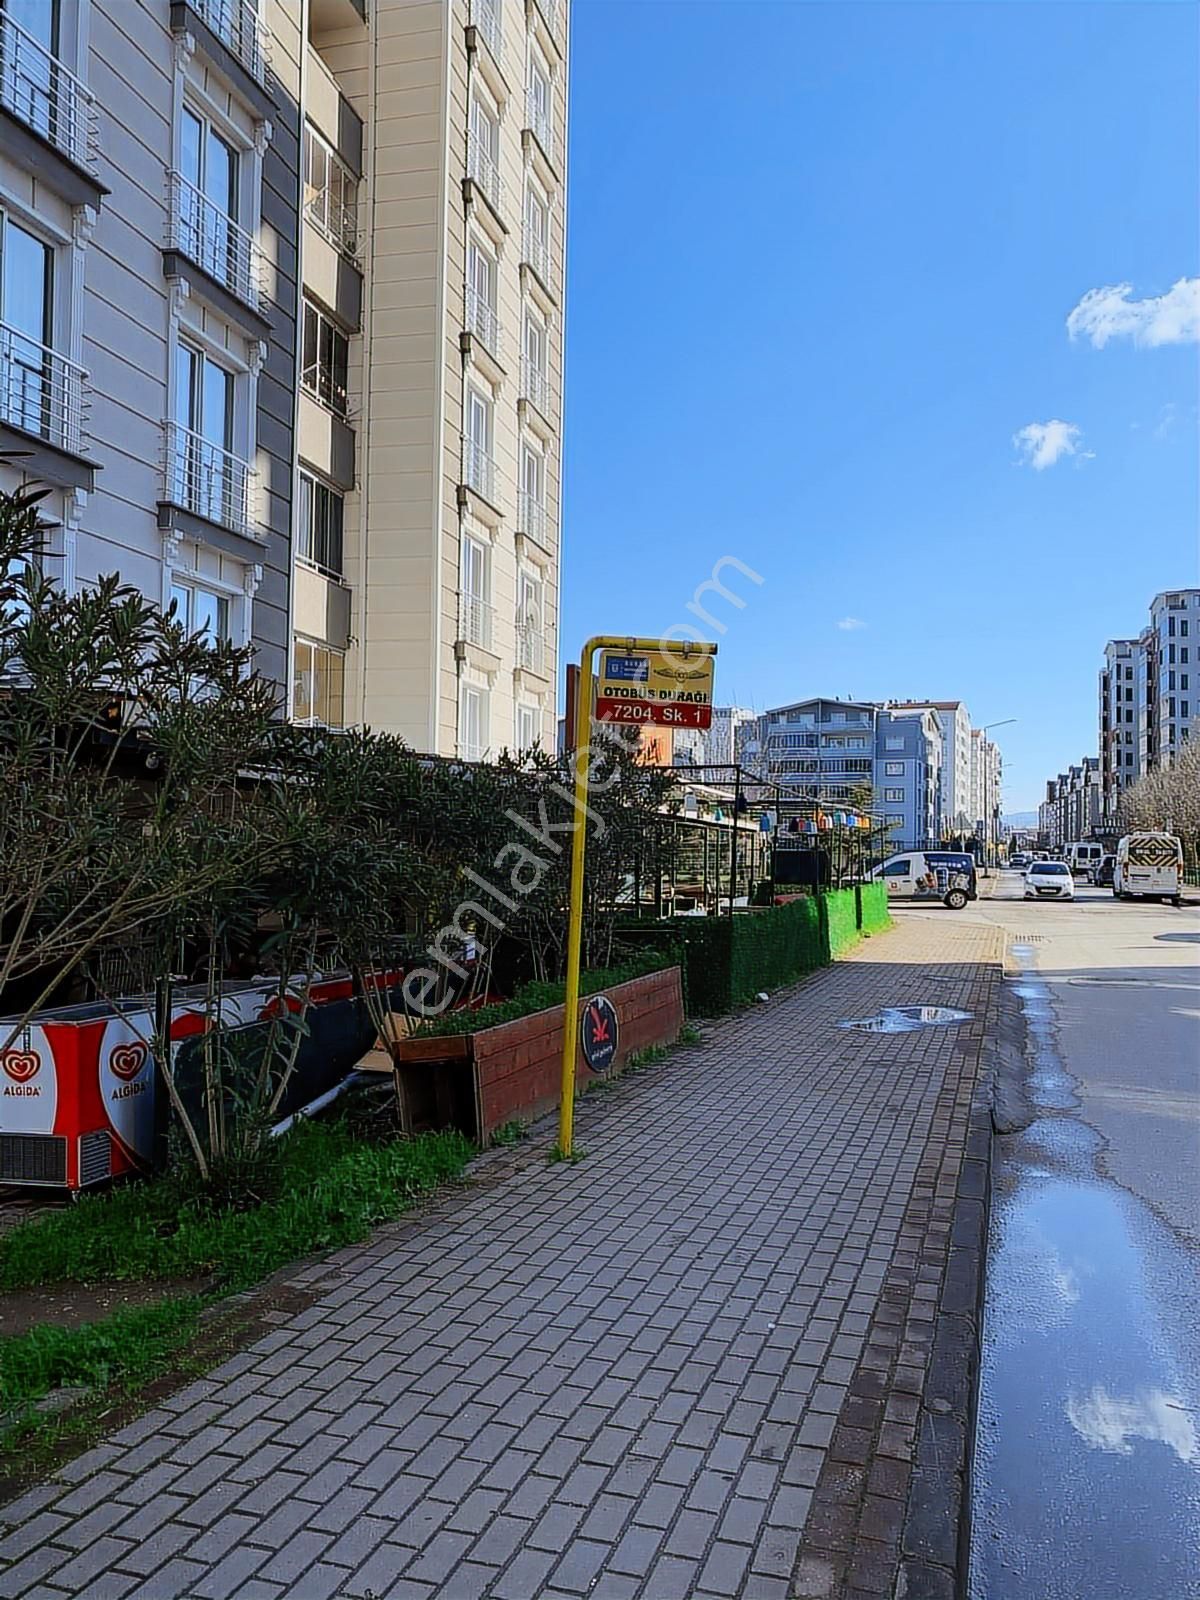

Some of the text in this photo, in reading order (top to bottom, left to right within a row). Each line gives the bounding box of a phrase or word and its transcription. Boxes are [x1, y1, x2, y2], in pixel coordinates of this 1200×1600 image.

[613, 704, 703, 724] 7204. Sk. 1
